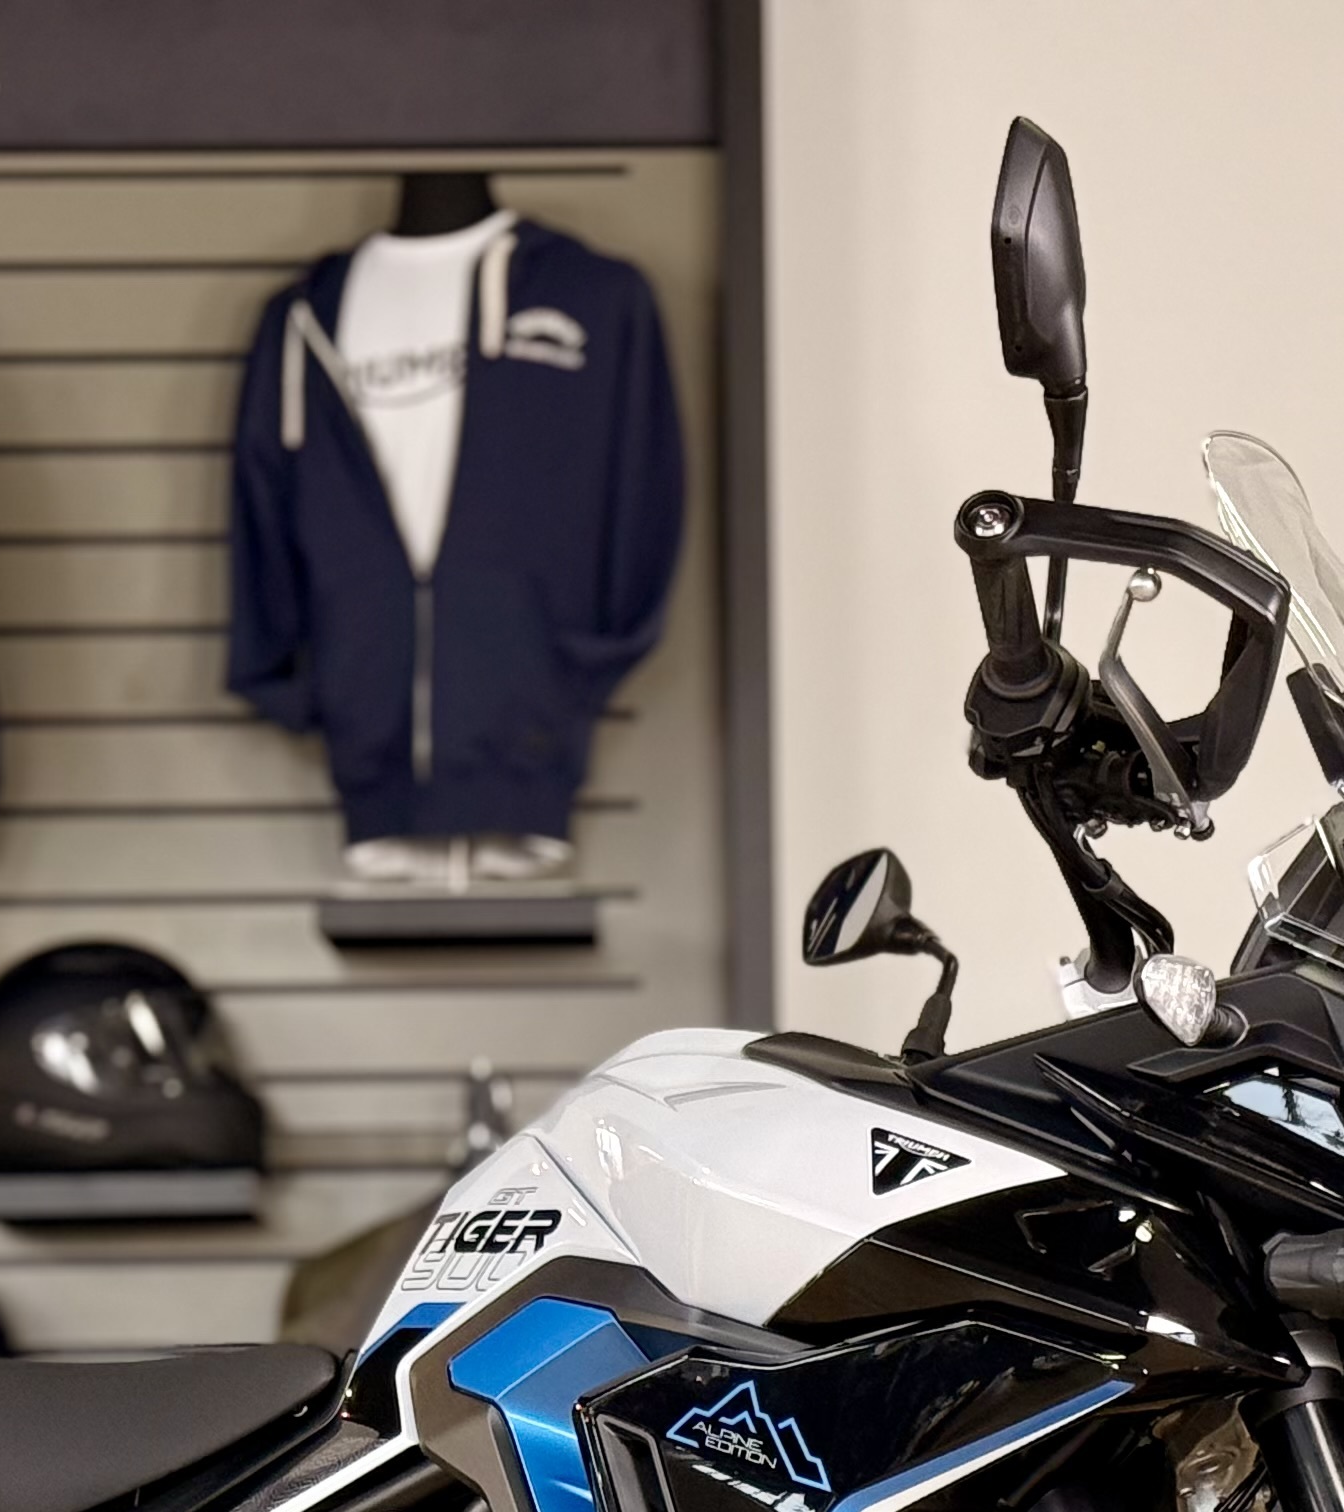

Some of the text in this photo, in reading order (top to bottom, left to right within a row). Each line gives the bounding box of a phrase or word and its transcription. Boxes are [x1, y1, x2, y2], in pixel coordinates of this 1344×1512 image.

[888, 1134, 950, 1161] TRIUMPH
[488, 1186, 538, 1205] GT
[420, 1209, 562, 1254] TIGER
[692, 1421, 764, 1453] ALPINE
[705, 1436, 777, 1469] EDITION
